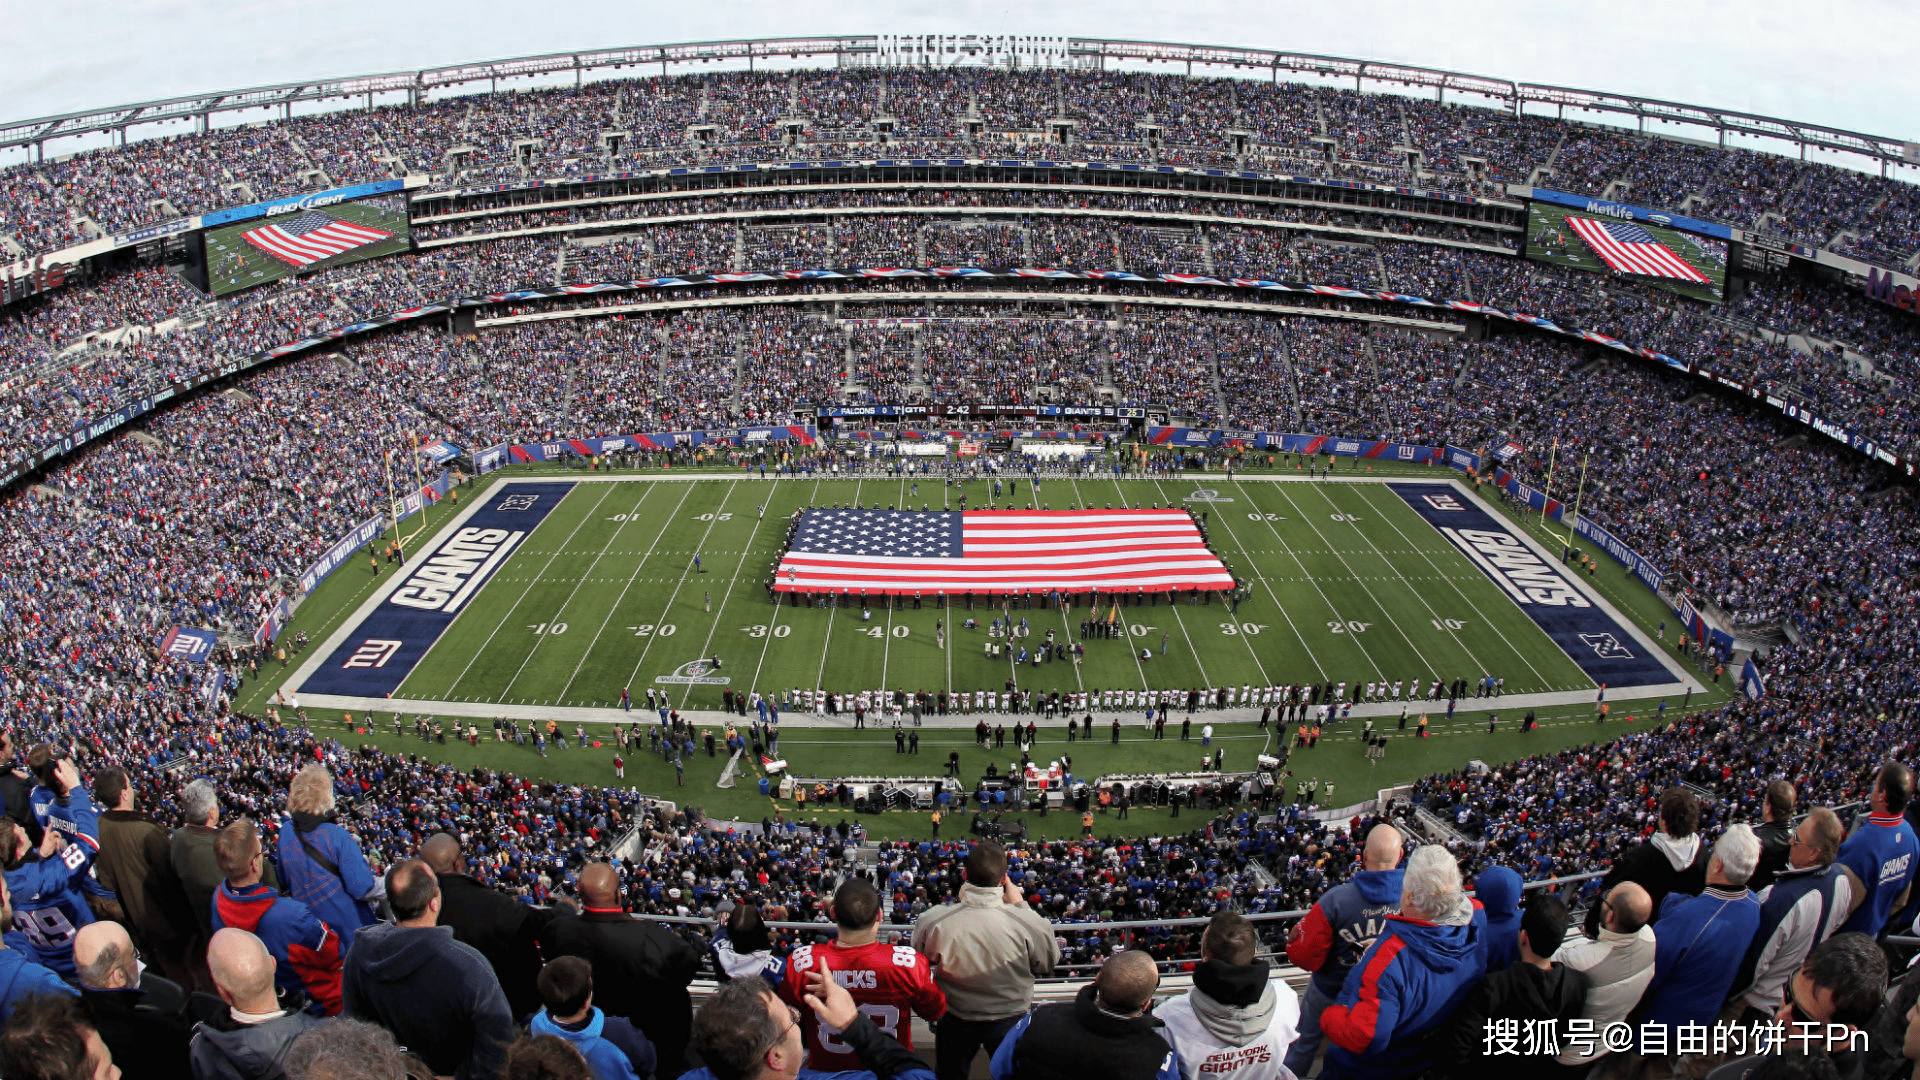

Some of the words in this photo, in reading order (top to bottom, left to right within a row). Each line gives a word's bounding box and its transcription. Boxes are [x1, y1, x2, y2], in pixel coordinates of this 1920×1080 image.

[976, 34, 1068, 58] STADIUM
[266, 202, 298, 216] BUD
[307, 193, 346, 208] LIGHT
[1587, 201, 1633, 219] MetLife
[220, 364, 237, 376] 2:42
[142, 400, 149, 411] 0
[946, 405, 969, 414] 2:42
[1064, 407, 1101, 415] GIANTS
[90, 414, 125, 439] MetLife
[1813, 418, 1848, 444] MetLife
[331, 533, 360, 565] FOOTBALL
[1590, 525, 1608, 547] YORK
[1608, 540, 1638, 570] FOOTBALL
[1638, 562, 1660, 589] GIANTS
[389, 526, 510, 611] GIANTS
[1457, 528, 1592, 608] GIANTS
[534, 622, 568, 635] 10
[634, 624, 677, 637] 20
[748, 624, 791, 638] 30
[866, 625, 910, 638] 40
[1218, 622, 1260, 635] 30
[1327, 620, 1366, 634] 20
[1431, 618, 1463, 631] 10
[1880, 853, 1912, 879] GIANTS
[792, 945, 813, 973] 88
[892, 945, 917, 968] 88
[1199, 1052, 1271, 1073] GIANTS
[1206, 1052, 1236, 1062] NEW
